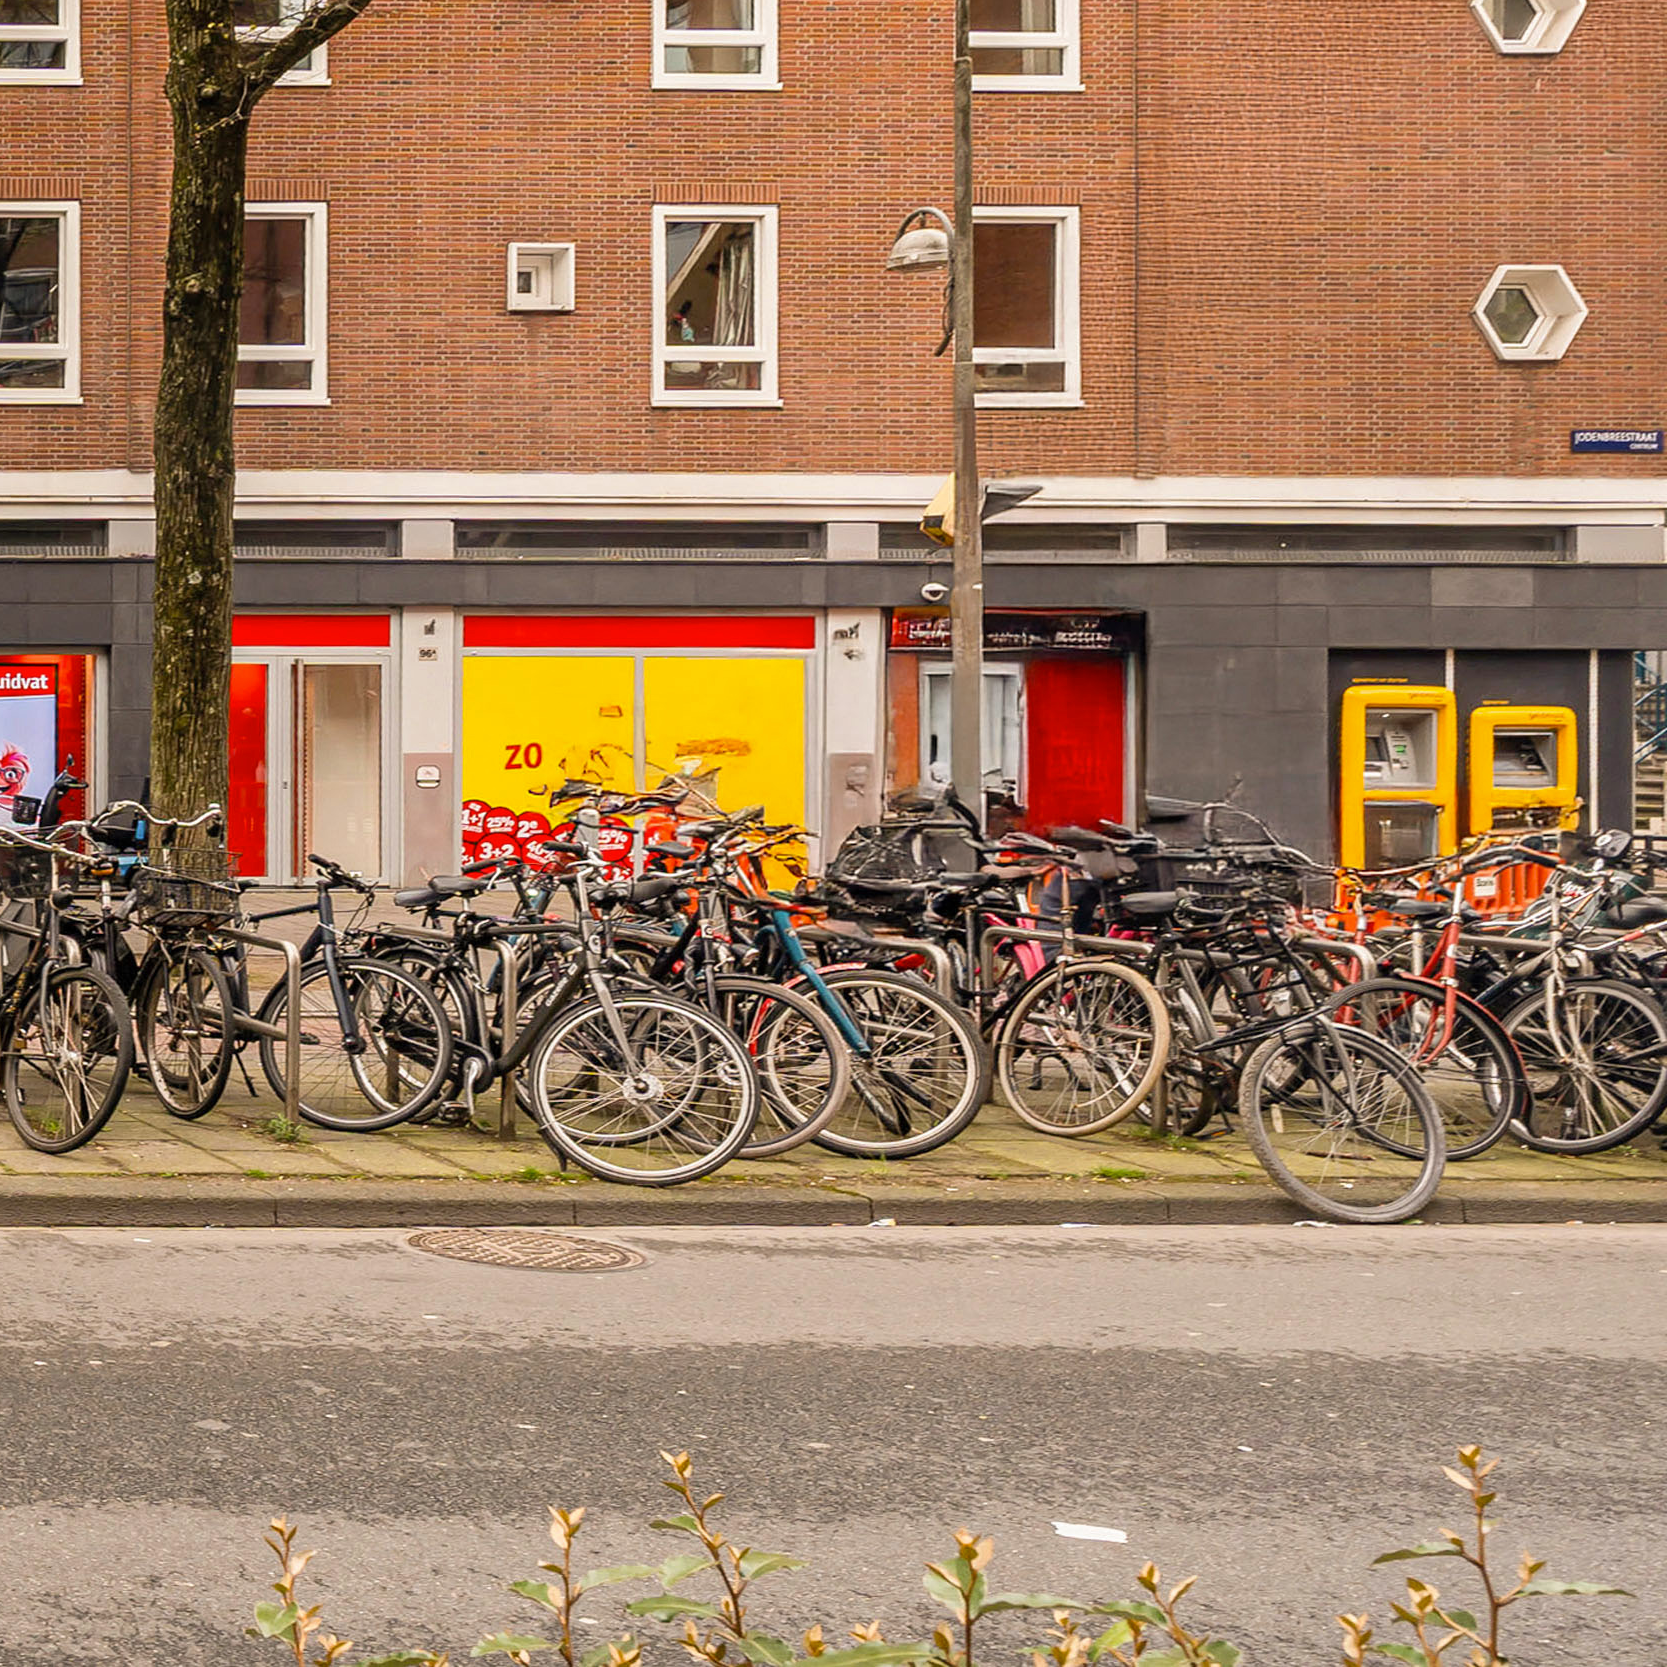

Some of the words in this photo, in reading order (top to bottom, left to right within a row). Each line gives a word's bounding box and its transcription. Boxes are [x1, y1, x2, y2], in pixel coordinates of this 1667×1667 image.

[504, 742, 543, 770] ZO
[486, 816, 516, 828] 25%
[598, 829, 628, 844] 5%
[479, 842, 515, 859] 3+2
